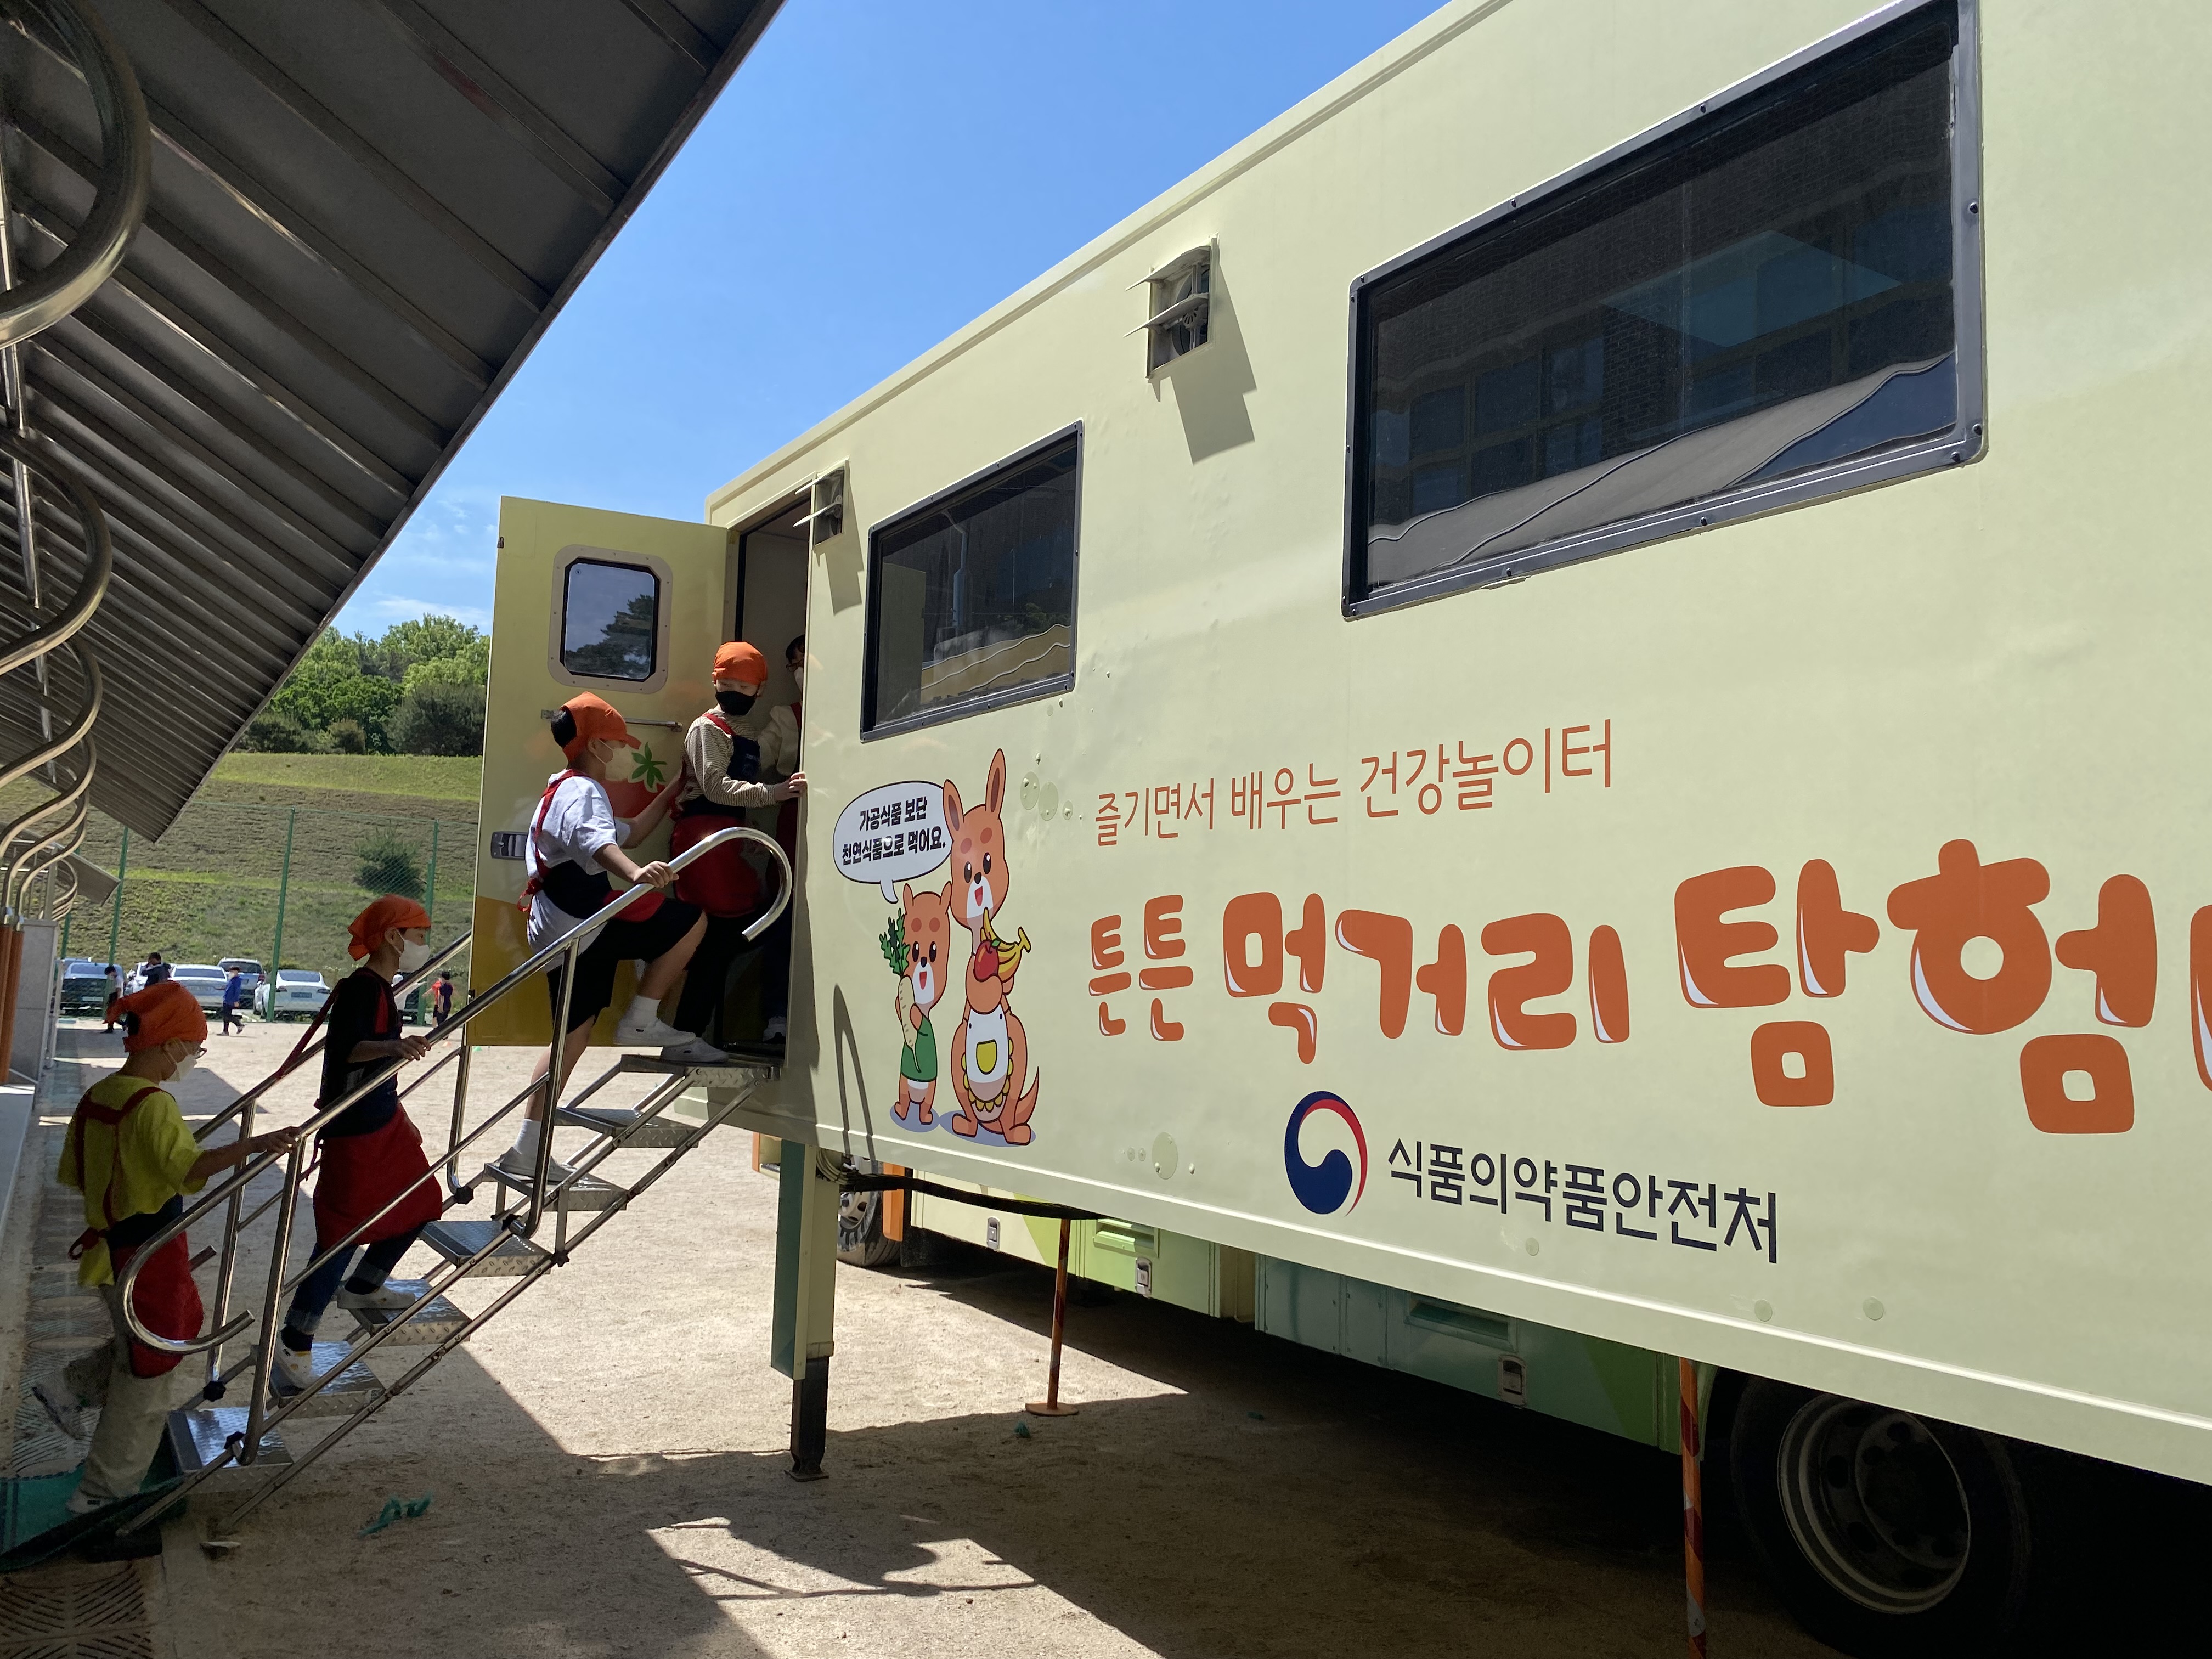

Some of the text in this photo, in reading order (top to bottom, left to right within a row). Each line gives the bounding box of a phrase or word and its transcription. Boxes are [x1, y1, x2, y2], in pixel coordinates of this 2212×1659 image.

[842, 826, 946, 866] 천연식품으로 먹어요.
[859, 796, 928, 832] 가공식품 보단
[1096, 719, 1611, 847] 즐기면서 배우는 건강놀이터
[1088, 839, 2212, 1134] 튼튼 먹거리 탐험
[1388, 1137, 1778, 1264] 식품의약품안전처
